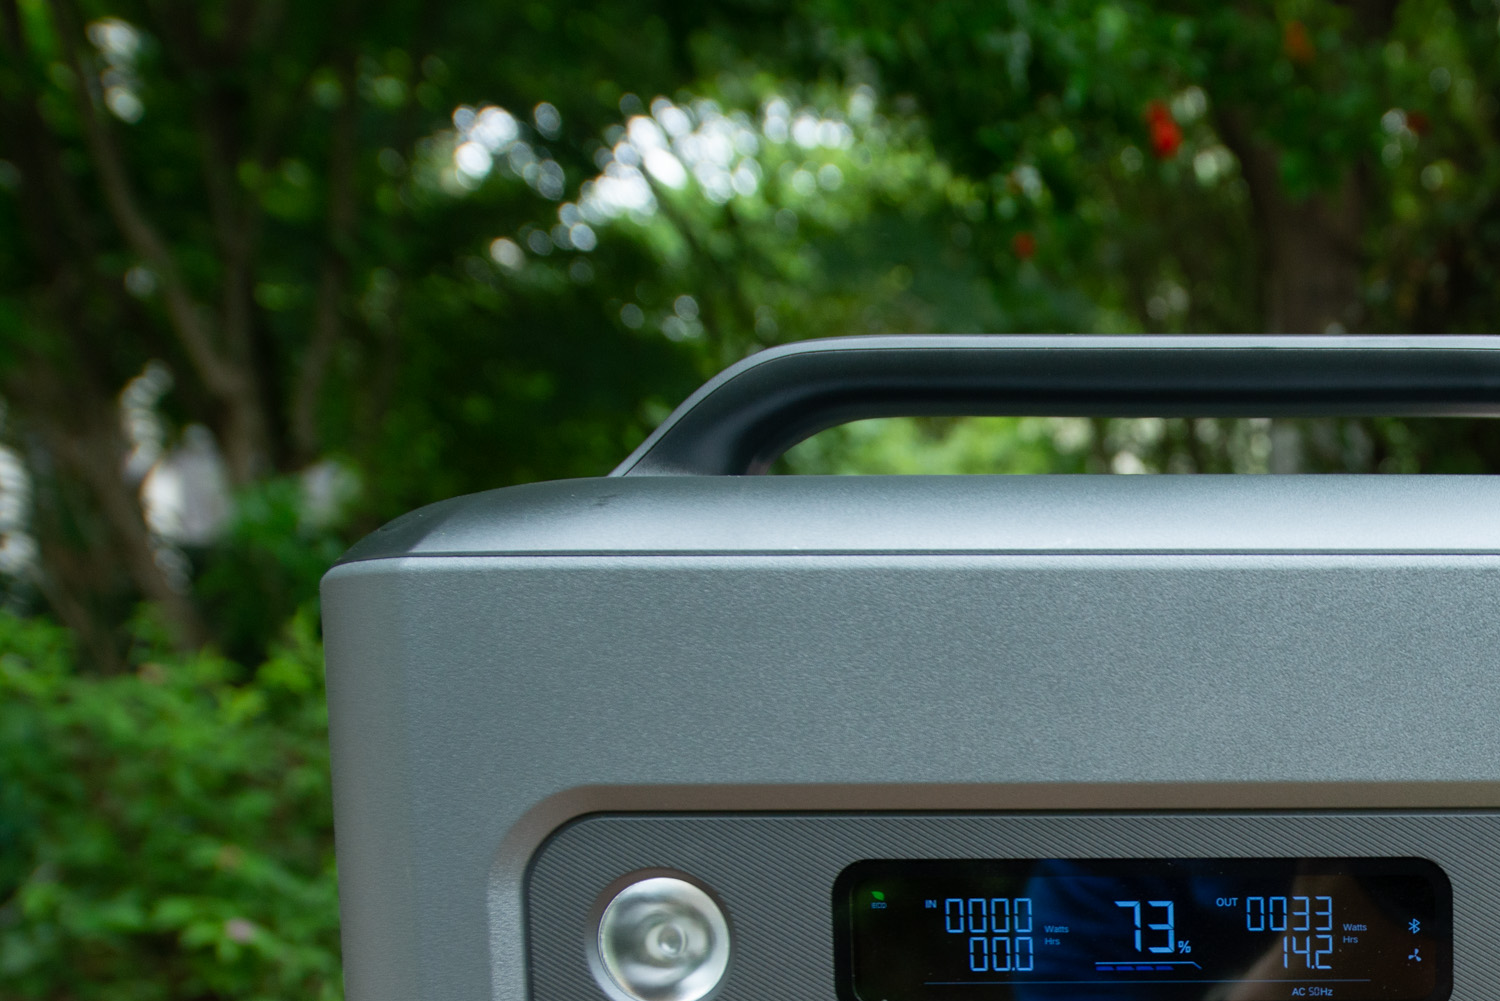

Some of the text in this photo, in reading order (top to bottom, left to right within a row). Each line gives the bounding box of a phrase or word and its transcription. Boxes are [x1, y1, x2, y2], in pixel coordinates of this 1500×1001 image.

[925, 898, 1032, 933] IN 0000
[1216, 896, 1332, 931] OUT 0033
[1045, 925, 1069, 933] Watts
[1343, 923, 1367, 931] Watts
[1045, 937, 1060, 946] Hrs
[1343, 935, 1358, 944] Hrs
[970, 937, 1034, 972] 00.0
[1283, 935, 1333, 969] 14.2
[1292, 987, 1333, 997] AC 50Hz
